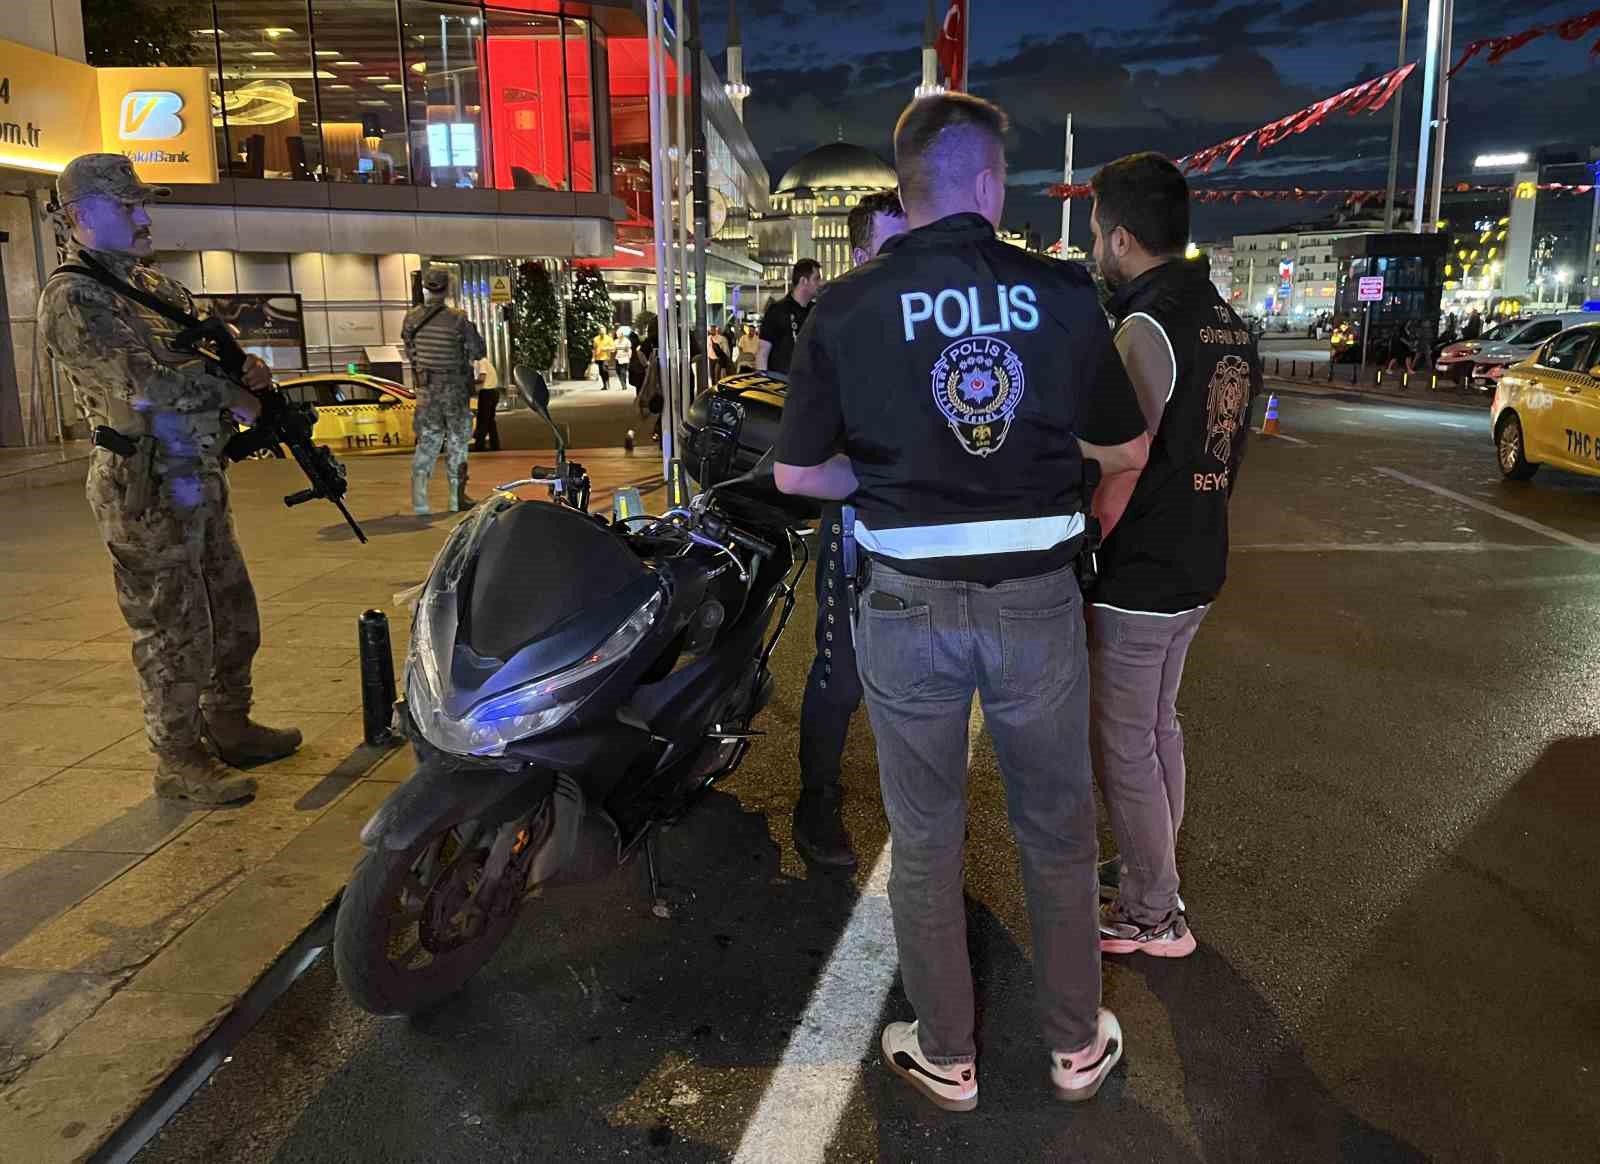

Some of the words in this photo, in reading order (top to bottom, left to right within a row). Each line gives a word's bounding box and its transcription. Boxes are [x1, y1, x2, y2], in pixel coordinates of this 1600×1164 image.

[344, 433, 379, 449] THF
[382, 431, 400, 448] 41
[1565, 429, 1592, 457] THC
